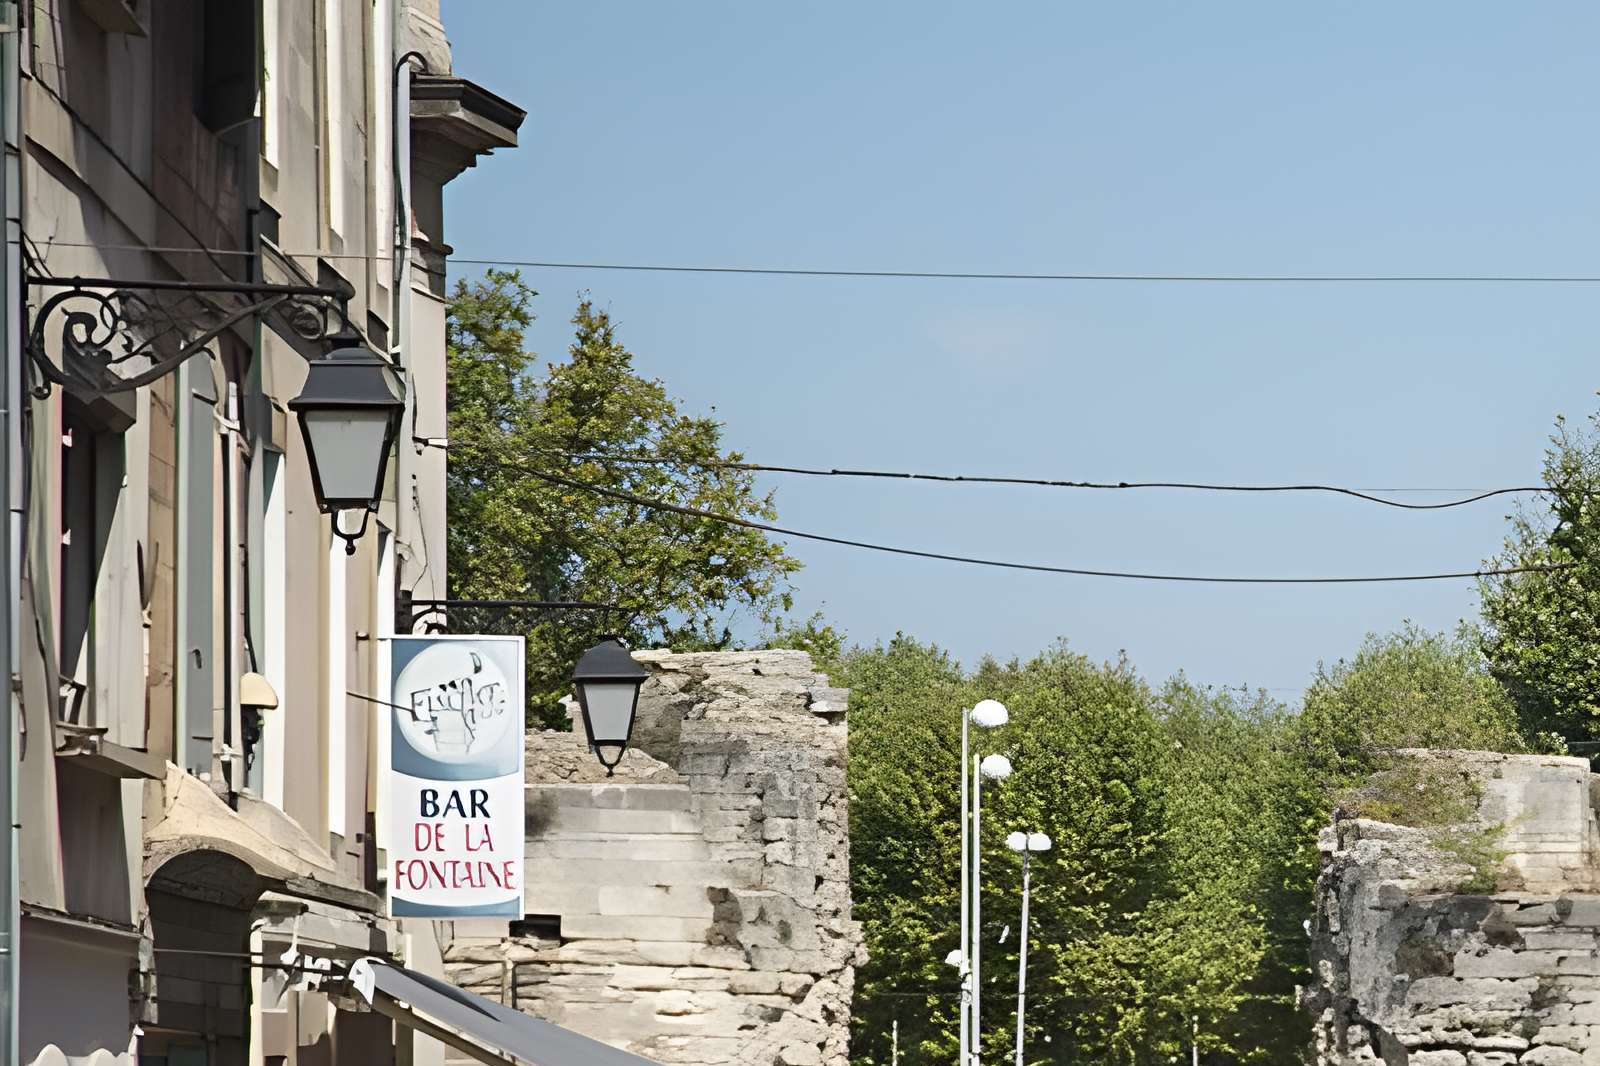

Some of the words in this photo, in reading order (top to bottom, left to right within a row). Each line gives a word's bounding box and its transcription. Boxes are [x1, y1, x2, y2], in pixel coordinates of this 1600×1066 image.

[419, 788, 490, 819] BAR
[414, 823, 446, 852] DE
[465, 823, 495, 852] LA
